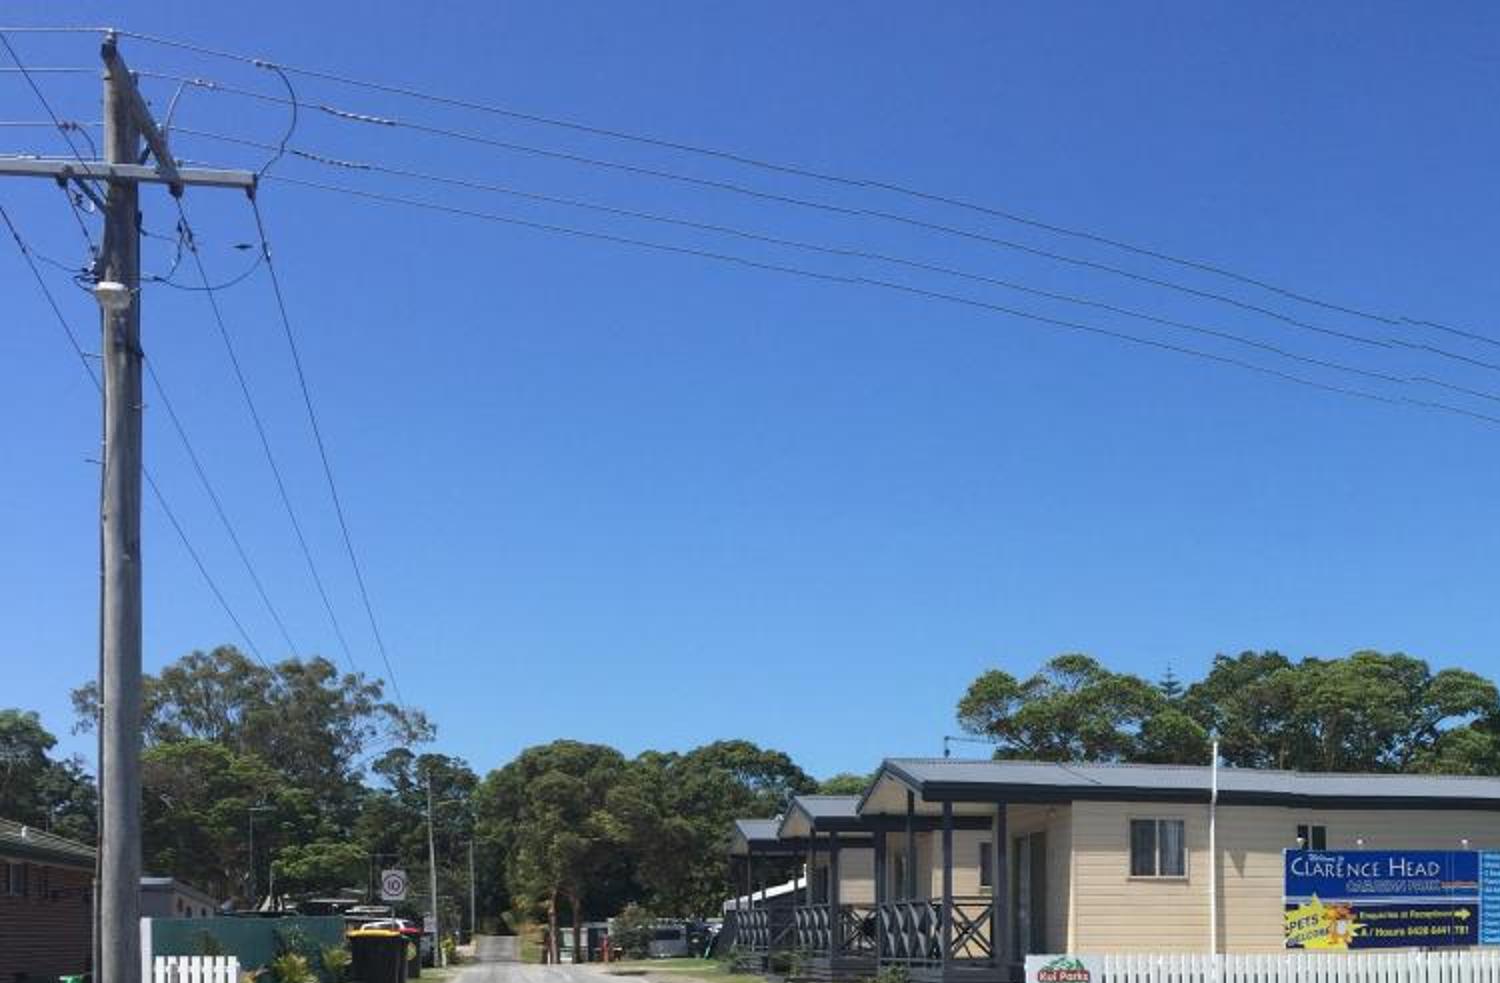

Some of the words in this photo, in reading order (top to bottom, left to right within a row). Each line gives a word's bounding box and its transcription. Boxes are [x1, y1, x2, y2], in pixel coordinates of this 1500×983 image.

[1291, 857, 1380, 878] CLARENCE
[1389, 856, 1441, 877] HEAD
[387, 880, 401, 891] 10
